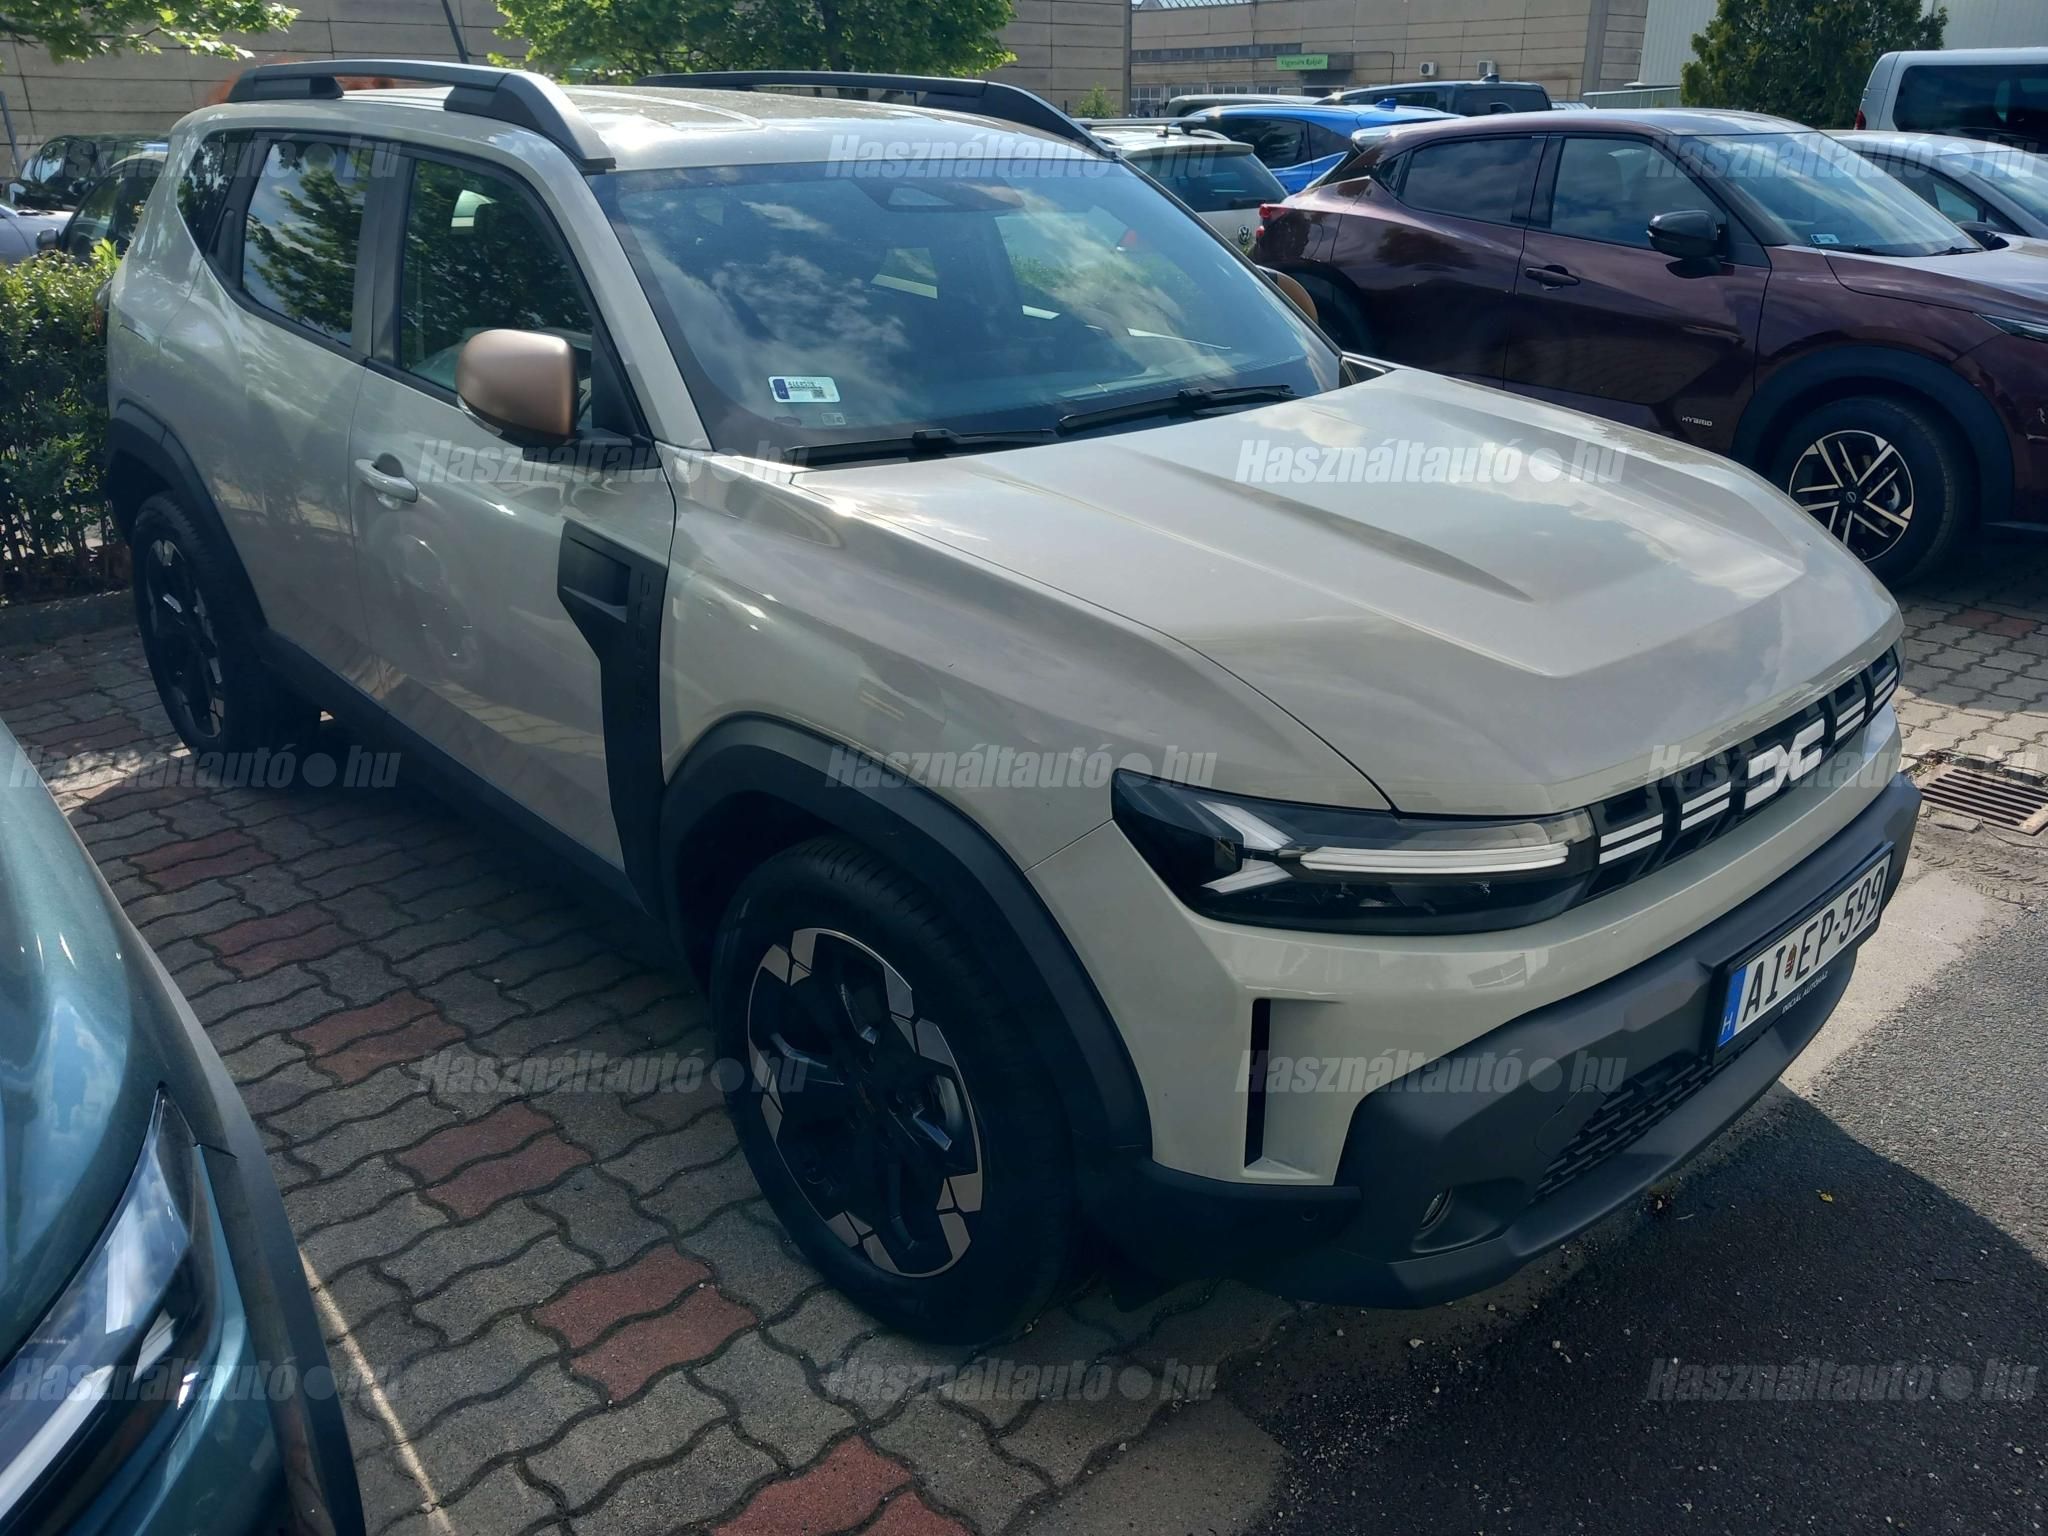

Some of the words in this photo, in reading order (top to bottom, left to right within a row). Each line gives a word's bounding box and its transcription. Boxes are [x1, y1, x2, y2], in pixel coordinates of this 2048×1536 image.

[1682, 416, 1713, 427] HYBRID
[1721, 1011, 1733, 1035] H
[1795, 866, 1885, 982] EP-599
